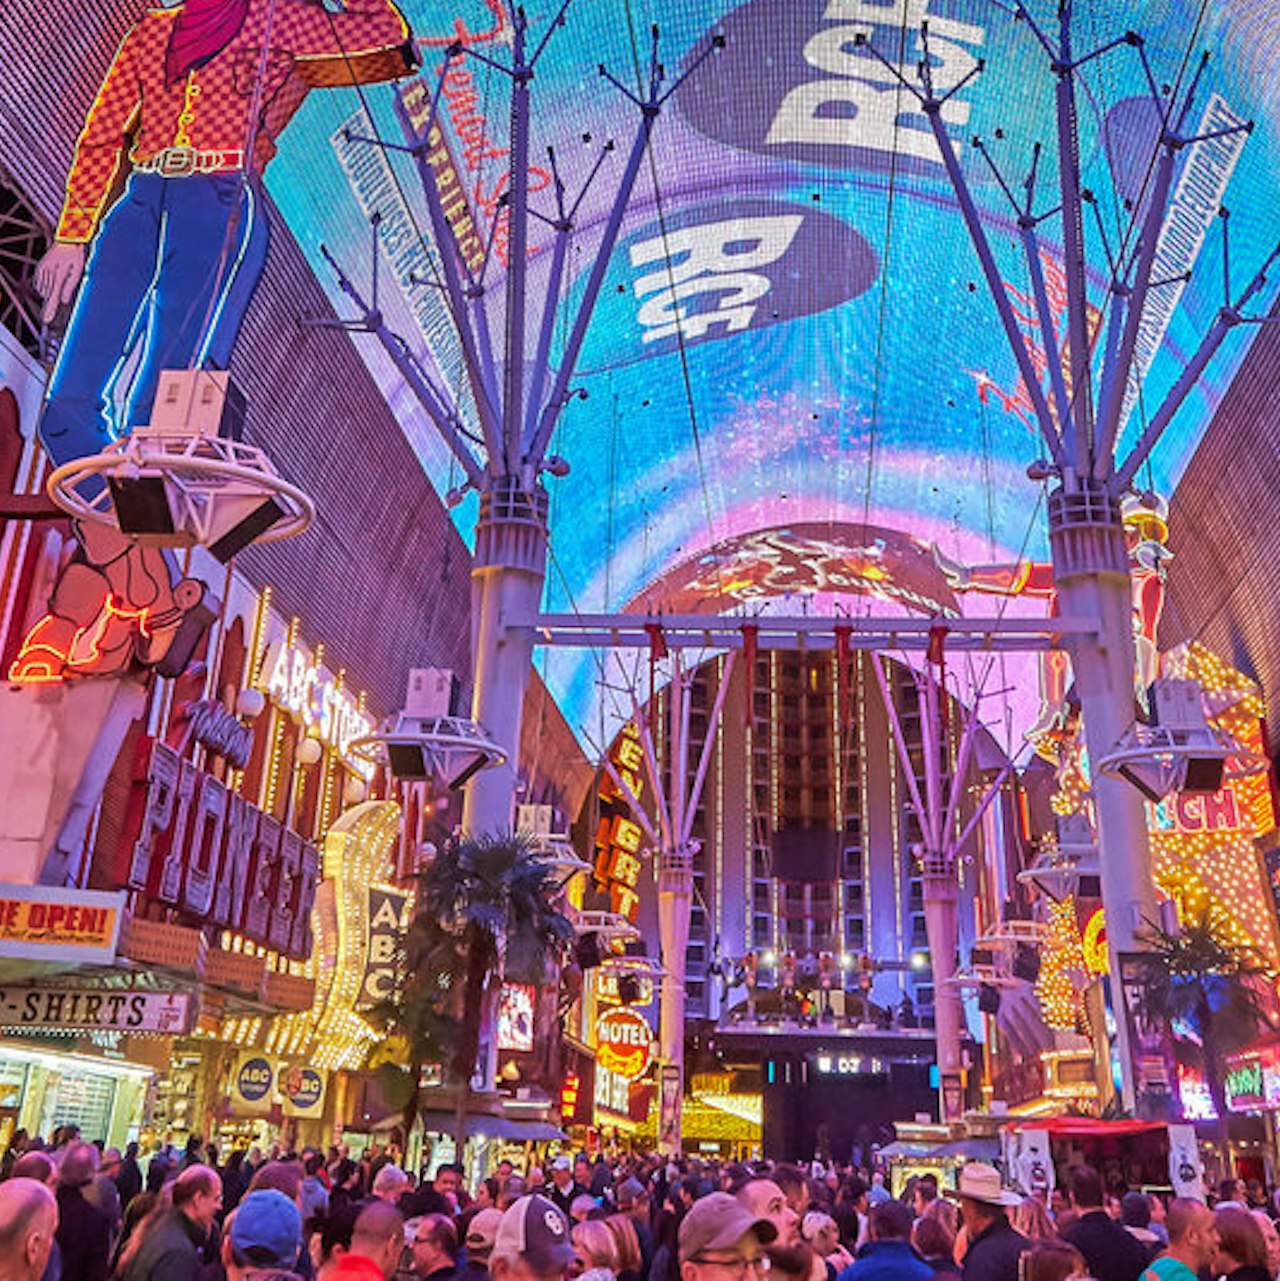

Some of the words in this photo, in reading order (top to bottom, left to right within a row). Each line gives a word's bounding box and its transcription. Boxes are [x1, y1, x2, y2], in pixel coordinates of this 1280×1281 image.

[629, 214, 807, 344] RCF
[27, 903, 109, 934] OPEN!
[364, 897, 400, 1001] ABC
